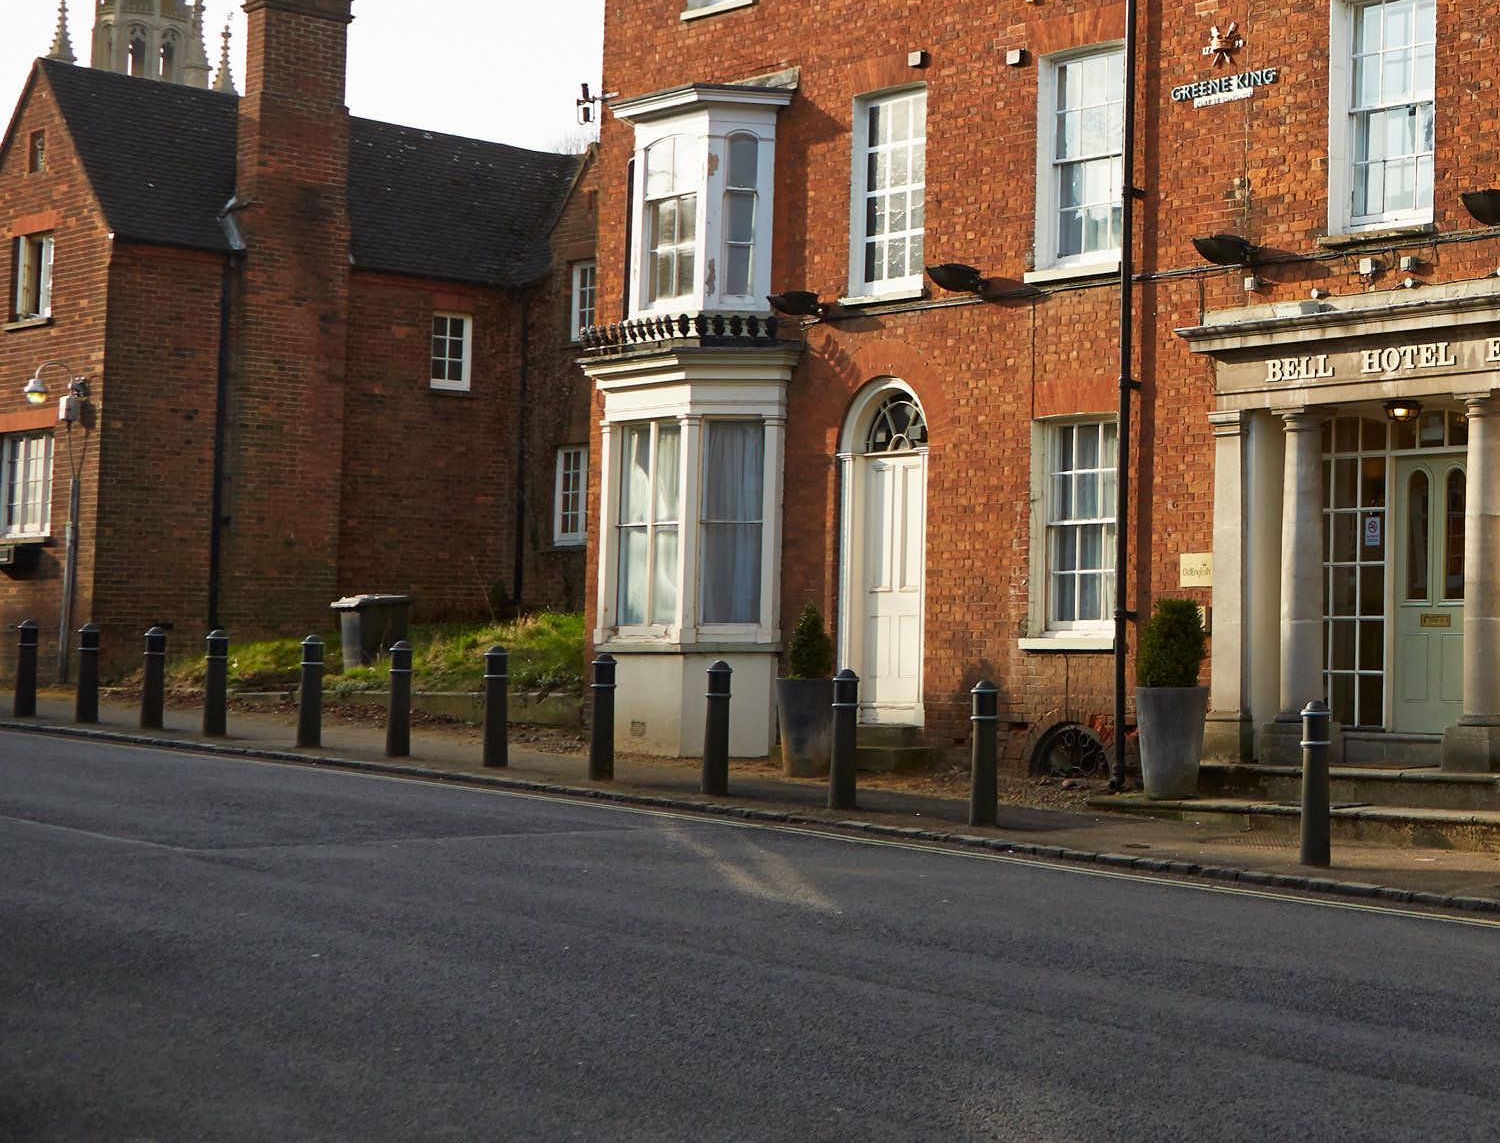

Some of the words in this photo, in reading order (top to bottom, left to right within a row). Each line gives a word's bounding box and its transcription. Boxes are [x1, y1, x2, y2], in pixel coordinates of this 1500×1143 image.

[1171, 77, 1233, 102] GREENE
[1236, 67, 1277, 89] KING
[1265, 354, 1334, 383] BELL
[1360, 342, 1457, 374] HOTEL
